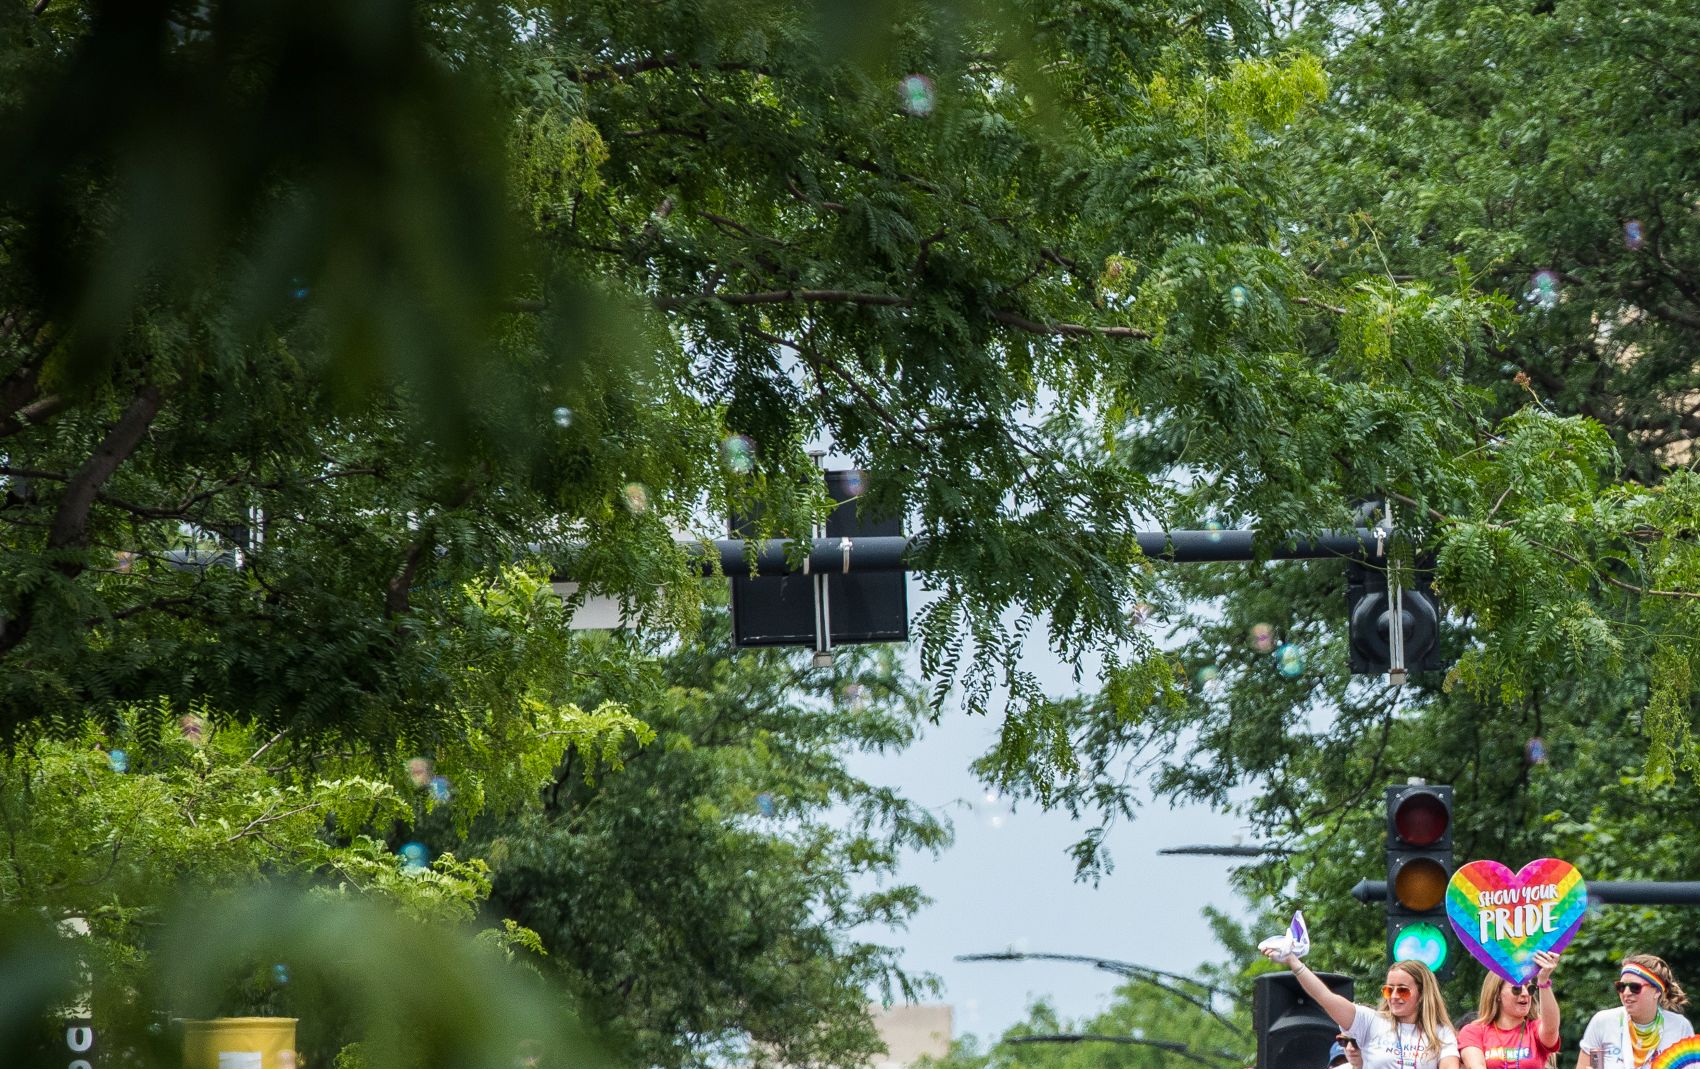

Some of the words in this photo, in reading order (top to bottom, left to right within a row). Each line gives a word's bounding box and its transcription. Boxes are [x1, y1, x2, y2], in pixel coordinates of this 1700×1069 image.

[1478, 887, 1520, 908] SHOW
[1522, 883, 1560, 904] YOUR
[1478, 901, 1560, 944] PRIDE
